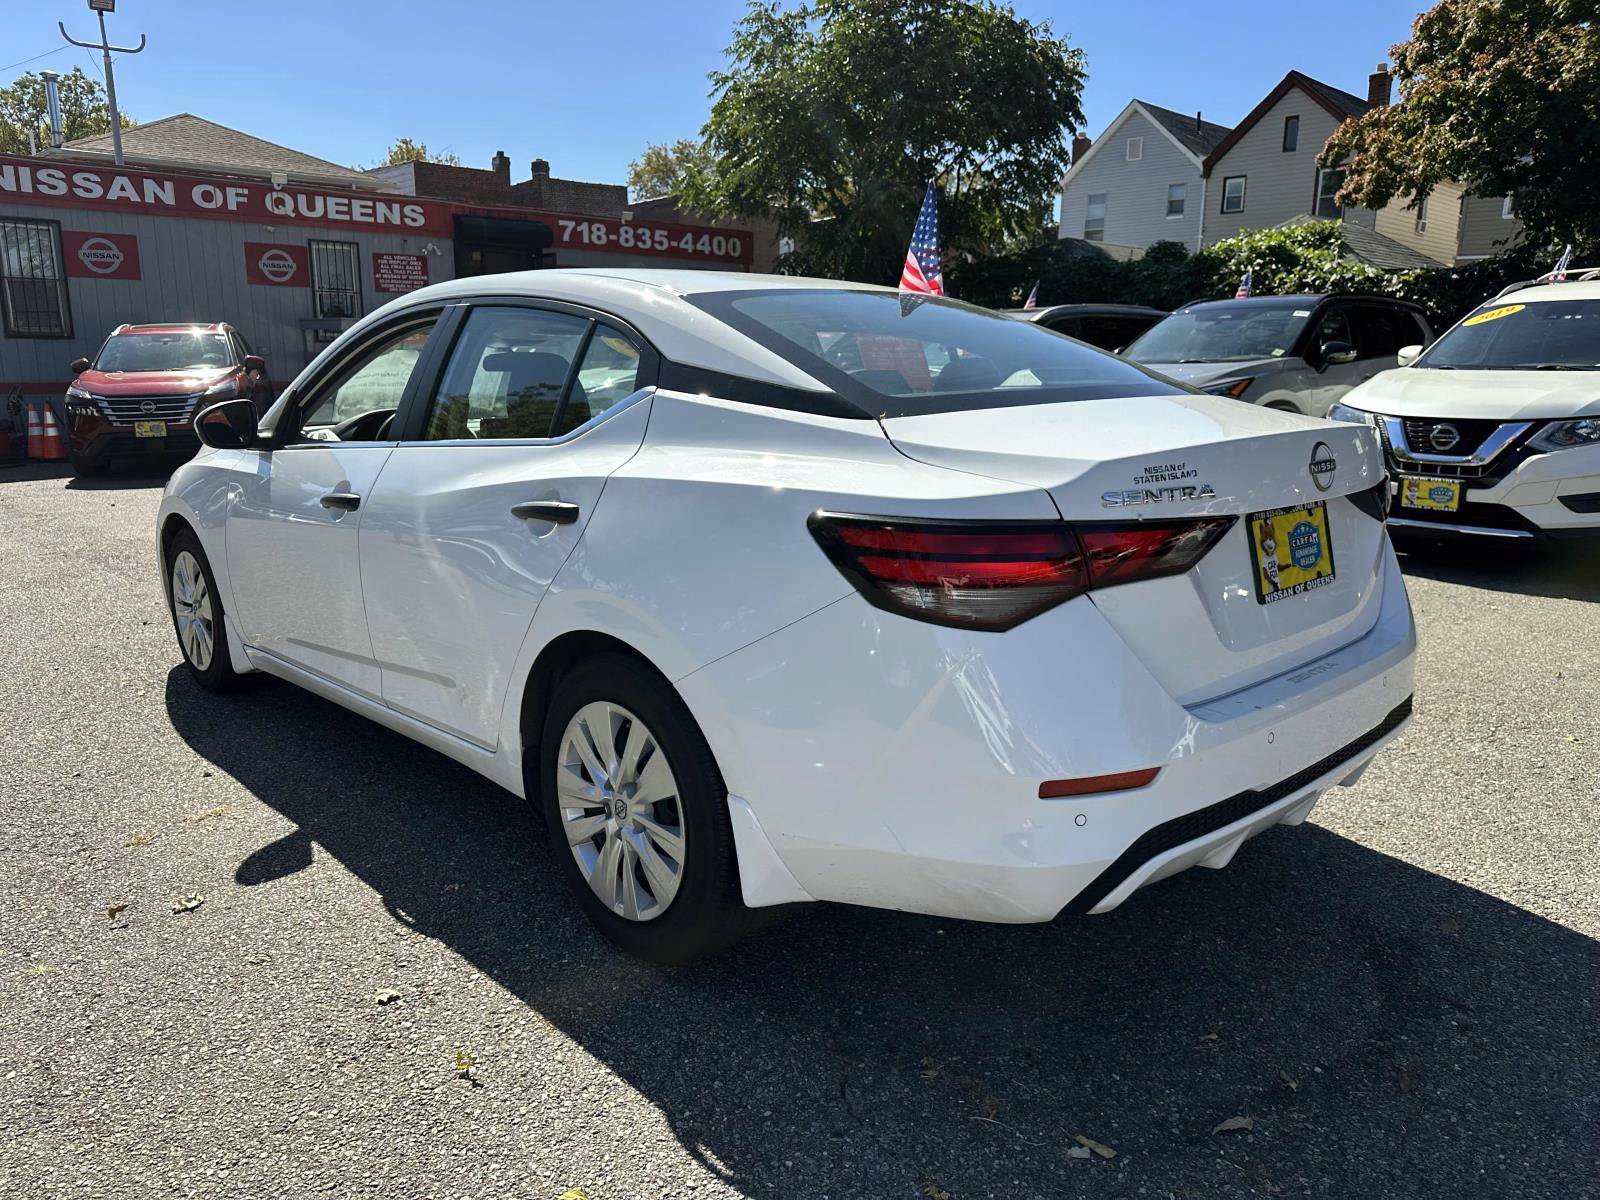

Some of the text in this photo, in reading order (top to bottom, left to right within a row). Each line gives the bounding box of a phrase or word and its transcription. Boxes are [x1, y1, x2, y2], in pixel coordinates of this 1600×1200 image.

[191, 184, 249, 211] OF
[264, 191, 426, 227] QUEENS
[558, 219, 742, 257] 718-835-4400
[82, 252, 120, 260] NISSAN
[262, 262, 294, 270] NISSAN
[1133, 469, 1198, 485] STATEN ISLAND
[1144, 464, 1176, 475] NISSAN
[1101, 484, 1216, 508] SENTRA
[1292, 533, 1319, 547] CARFAX
[1265, 574, 1335, 604] NISSAN OF QUEENS
